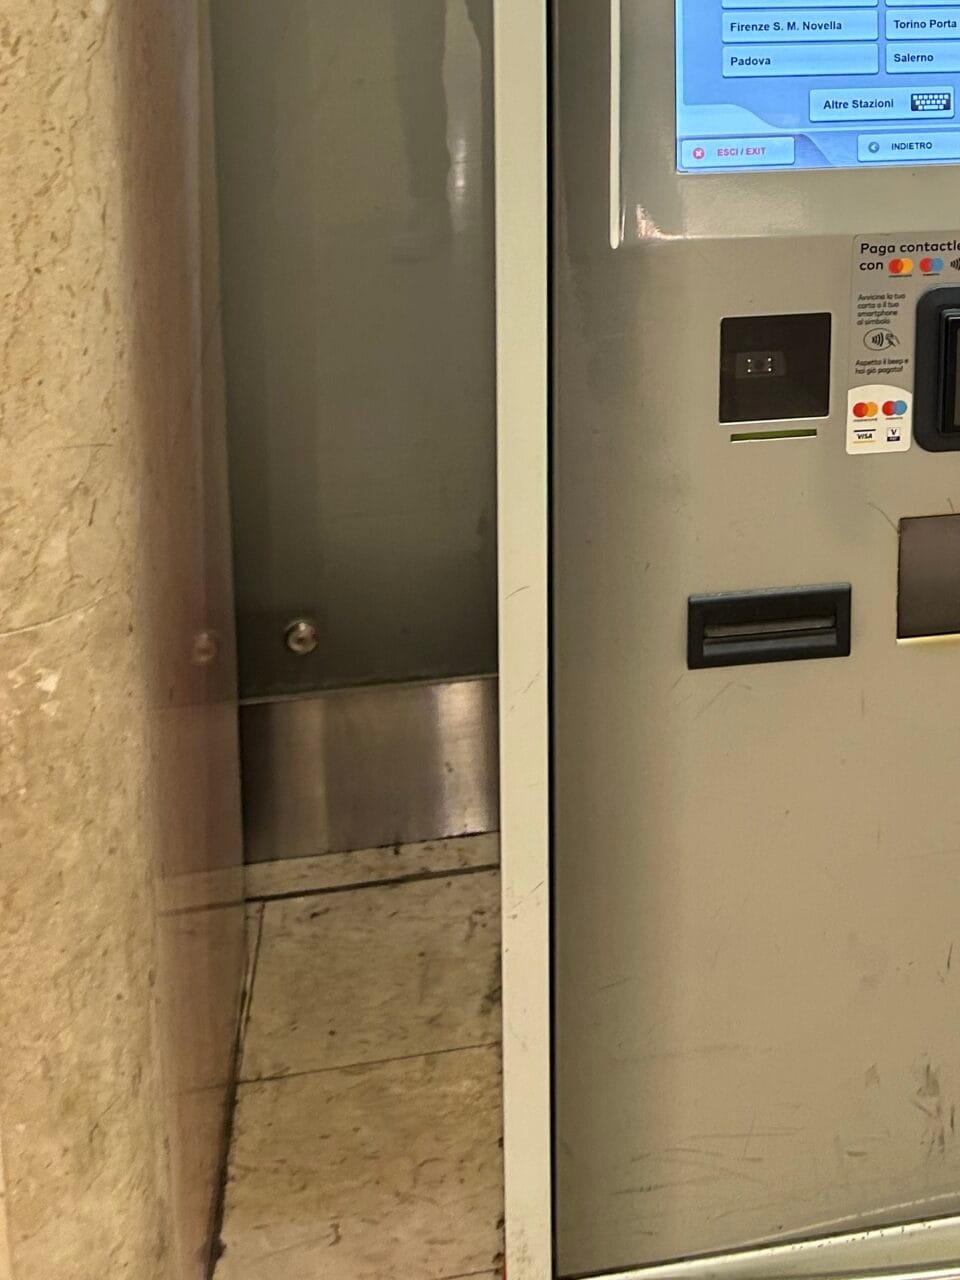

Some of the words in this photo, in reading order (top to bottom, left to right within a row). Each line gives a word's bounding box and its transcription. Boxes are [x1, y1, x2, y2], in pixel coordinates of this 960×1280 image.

[730, 22, 770, 32] Firenze
[773, 21, 784, 31] S.
[787, 21, 800, 31] M.
[802, 21, 842, 31] Novella
[893, 19, 927, 29] Torino
[929, 19, 957, 29] Porta
[730, 56, 771, 66] Padova
[893, 53, 934, 63] Salerno
[823, 99, 849, 110] Altre
[852, 98, 894, 109] Stazioni
[891, 141, 933, 151] INDIETRO
[717, 148, 739, 157] ESCI
[745, 147, 767, 156] EXIT
[860, 242, 896, 256] Paga
[859, 261, 884, 271] con
[857, 310, 898, 318] smartphone
